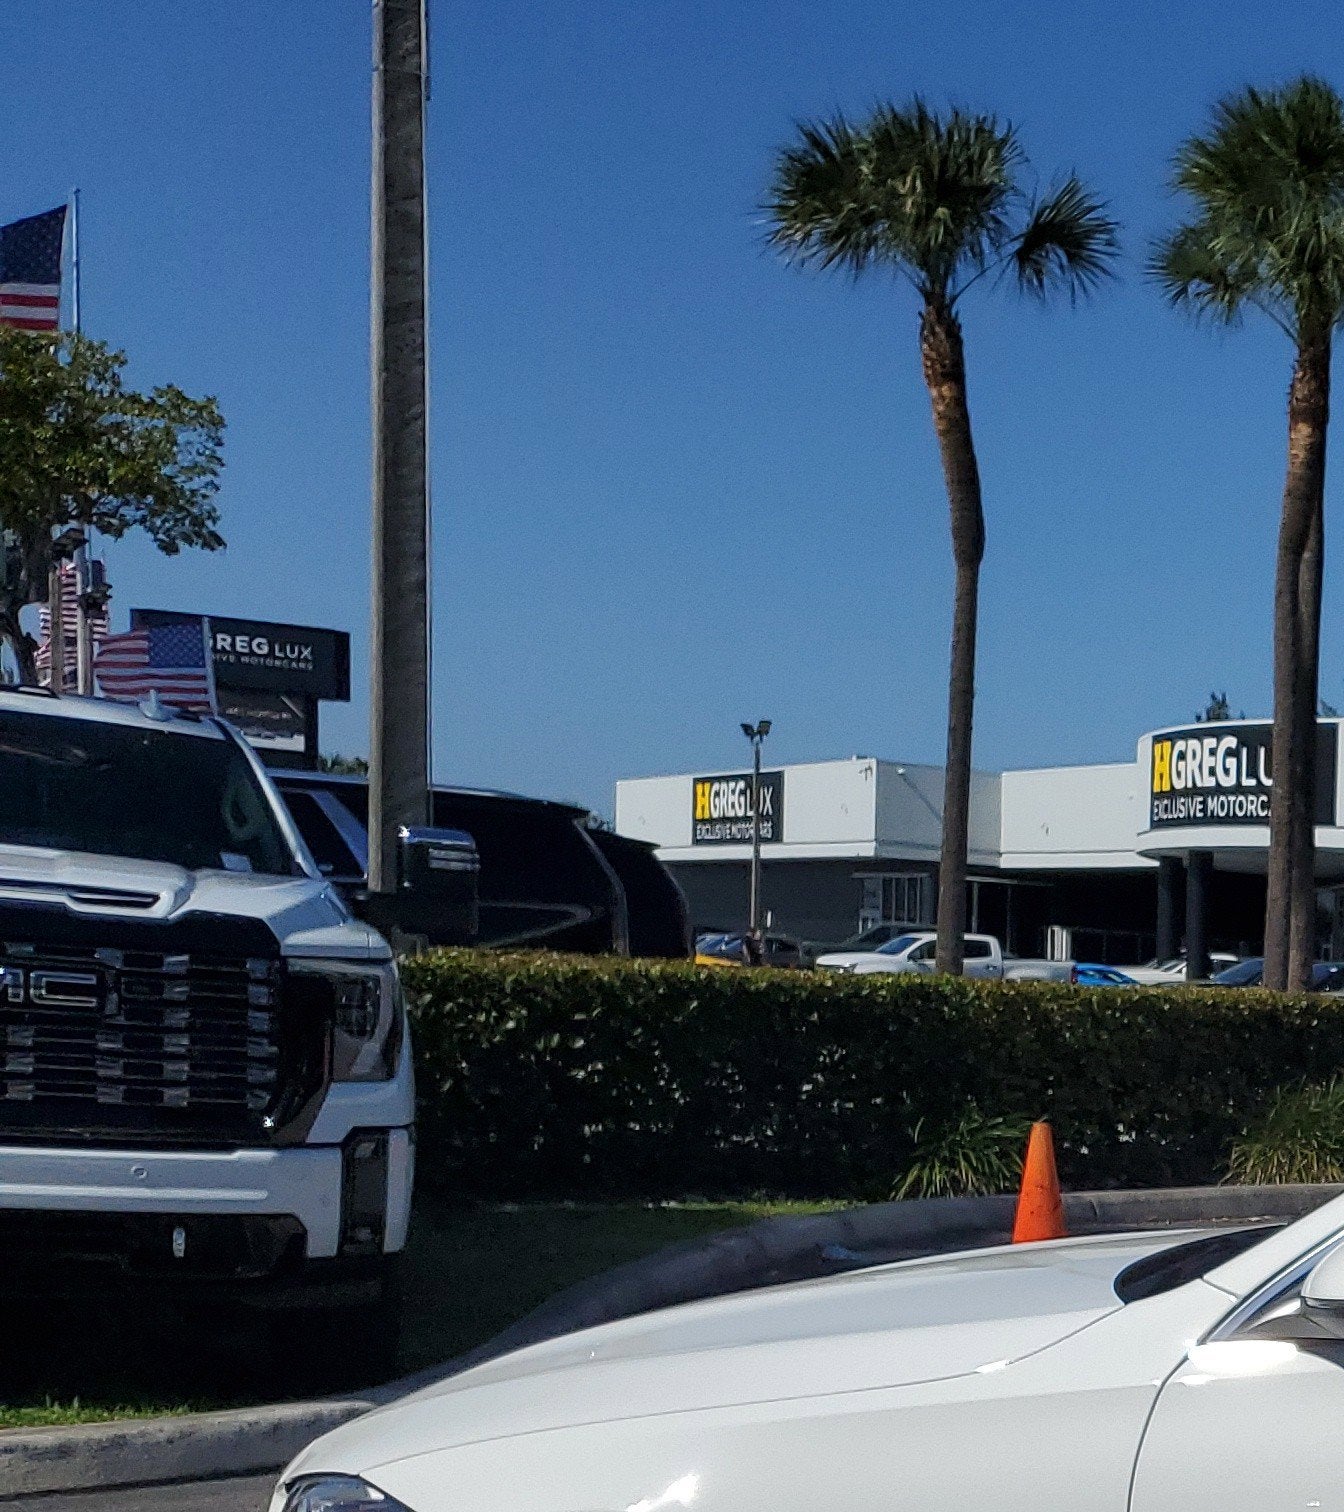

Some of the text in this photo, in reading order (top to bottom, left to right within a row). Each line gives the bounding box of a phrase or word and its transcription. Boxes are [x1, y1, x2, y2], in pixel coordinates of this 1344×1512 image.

[209, 632, 312, 660] REG LUX
[1153, 794, 1272, 821] EXCLUSIVE MOTORC
